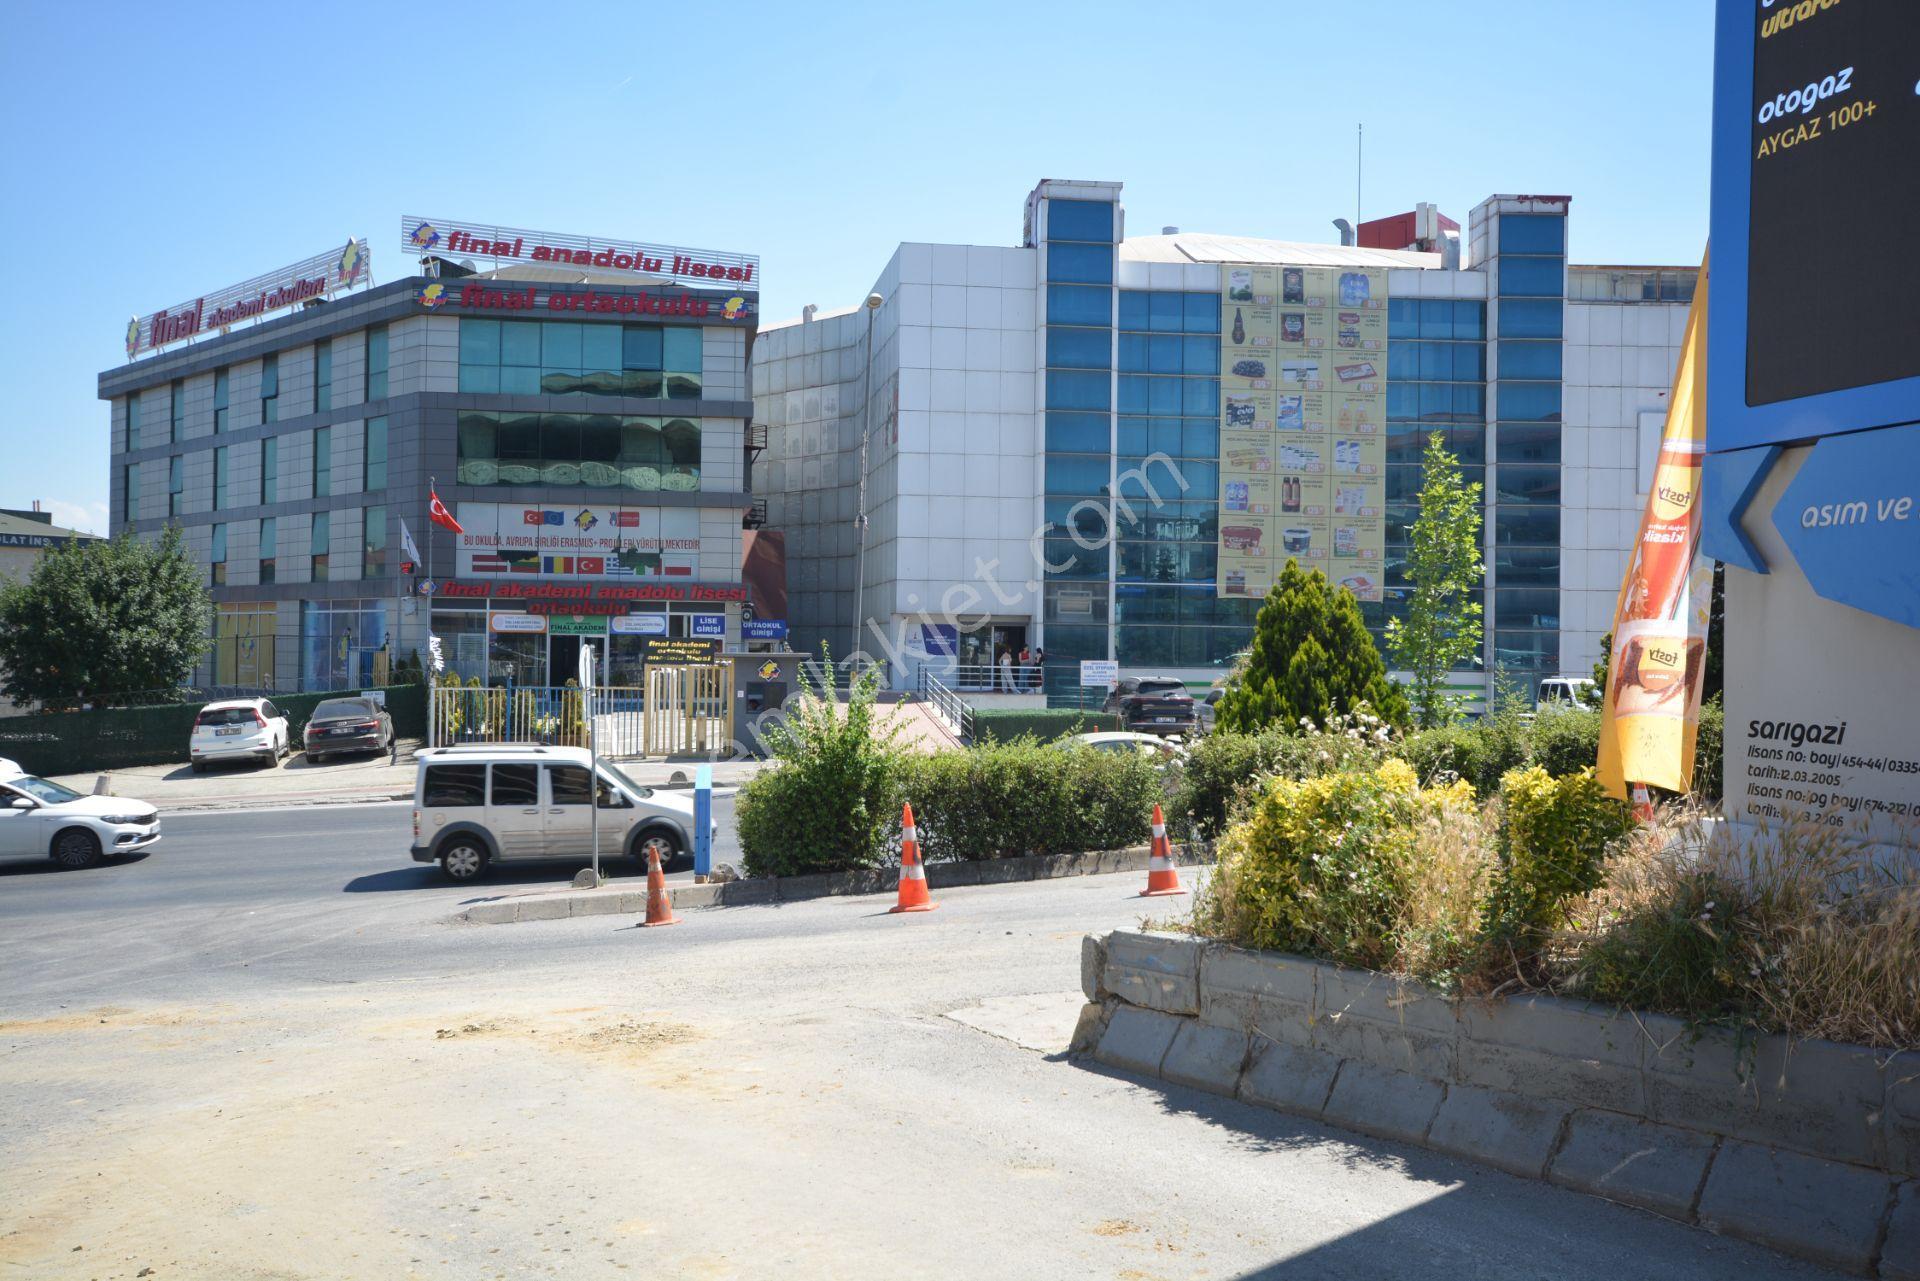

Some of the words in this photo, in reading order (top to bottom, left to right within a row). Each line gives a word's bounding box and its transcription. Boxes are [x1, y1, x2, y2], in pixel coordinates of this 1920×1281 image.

[1758, 66, 1854, 124] otogaz
[1757, 117, 1821, 160] AYGAZ
[1828, 100, 1877, 131] 100+
[447, 231, 524, 258] final
[531, 243, 663, 272] anadolu
[672, 255, 753, 282] lisesi
[460, 285, 536, 310] final
[547, 290, 709, 317] ortaokulu
[149, 298, 204, 347] final
[206, 292, 266, 329] akademi
[268, 277, 326, 309] okulları
[1801, 501, 1868, 528] asım
[1877, 496, 1913, 522] ve
[464, 535, 474, 546] BU
[506, 535, 533, 547] AVRUPA
[442, 582, 492, 597] final
[496, 584, 591, 599] akademi
[597, 584, 685, 600] anadolu
[690, 583, 747, 601] lisesi
[529, 600, 628, 616] ortaokulu
[696, 625, 721, 634] GİRİŞİ
[700, 617, 717, 625] LİSE
[751, 629, 773, 637] GİRİŞİ
[1747, 719, 1847, 748] sarıgazi
[1747, 745, 1783, 760] lisans
[1785, 751, 1806, 763] no:
[1747, 783, 1783, 799] lisans
